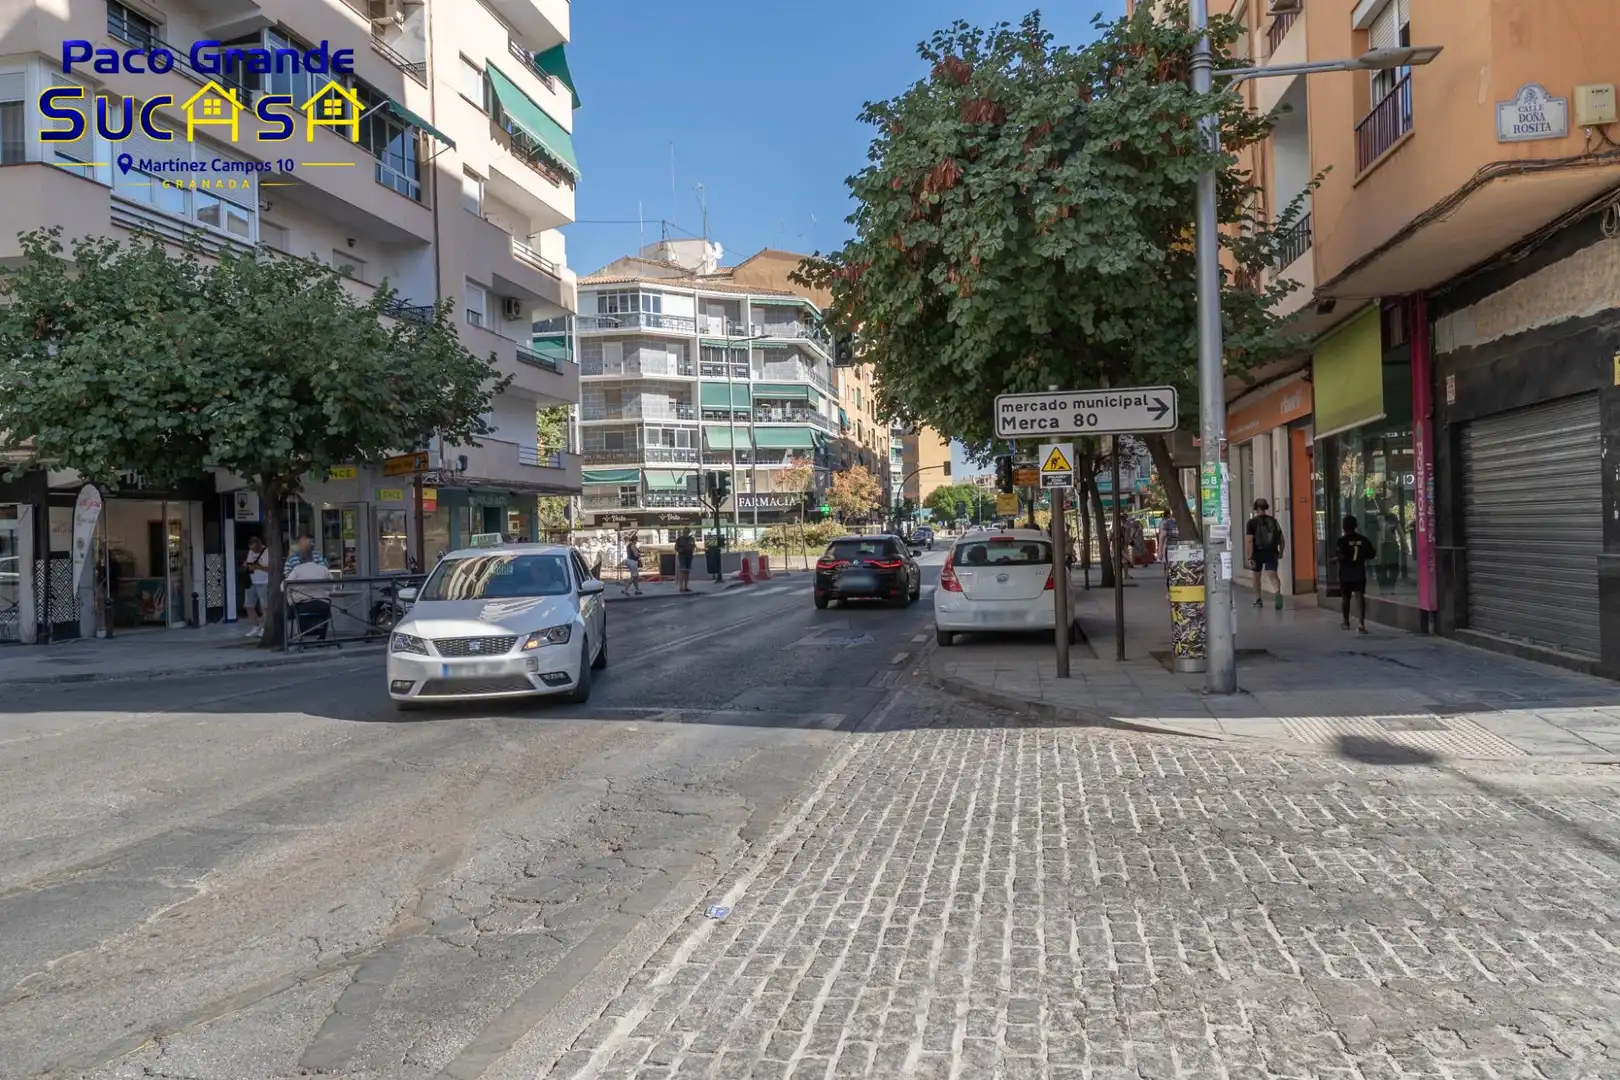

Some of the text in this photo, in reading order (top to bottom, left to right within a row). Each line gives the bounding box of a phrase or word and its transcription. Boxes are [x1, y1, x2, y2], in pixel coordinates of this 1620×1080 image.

[1518, 104, 1544, 113] CALLE
[1519, 112, 1546, 123] DOÑA
[1513, 122, 1552, 134] ROSITA
[1001, 394, 1148, 413] mercado municipal
[1001, 413, 1098, 430] Merca 80
[382, 489, 402, 499] ONCE
[738, 496, 796, 508] FARMACIA
